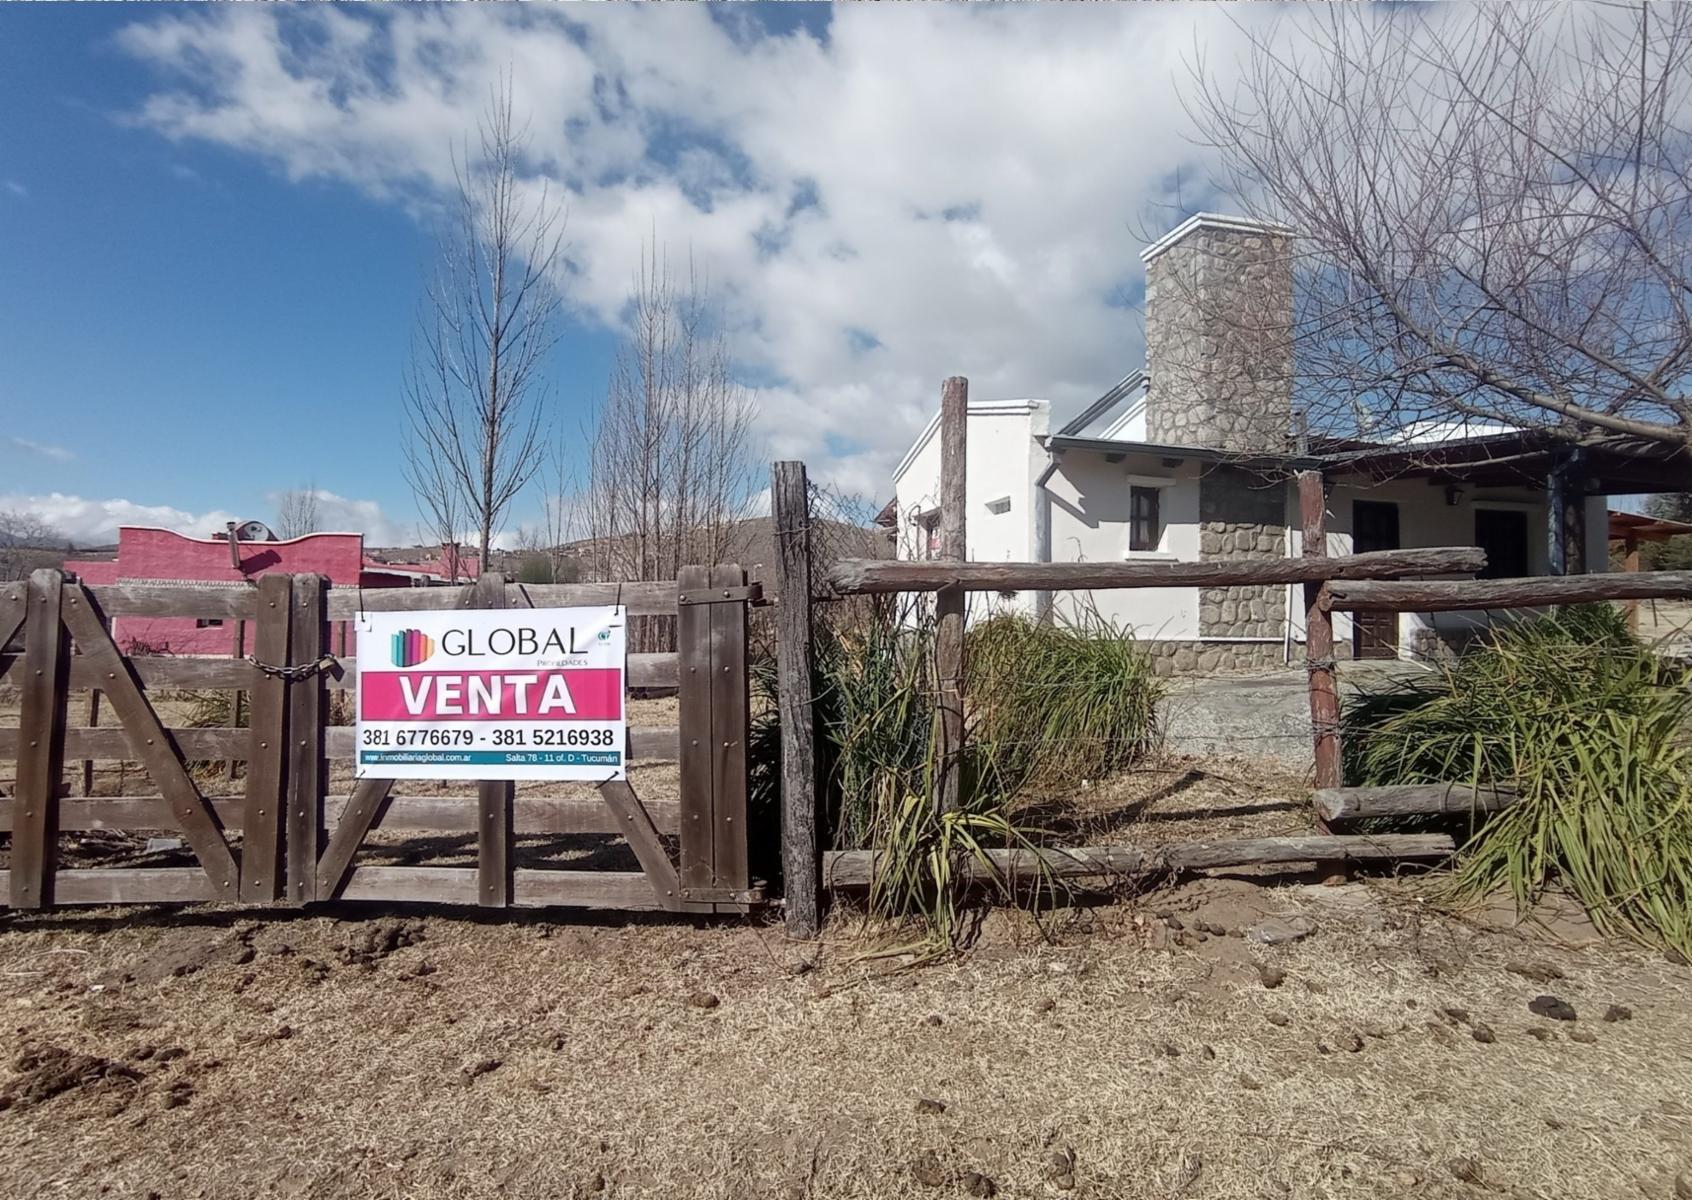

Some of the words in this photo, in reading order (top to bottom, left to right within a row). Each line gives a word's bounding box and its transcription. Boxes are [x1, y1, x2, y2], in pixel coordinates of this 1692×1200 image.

[442, 627, 589, 656] GLOBAL
[399, 674, 577, 715] VENTA
[363, 729, 391, 746] 381
[396, 729, 474, 746] 6776679
[492, 729, 527, 746] 381
[532, 729, 615, 746] 5216938
[505, 753, 526, 762] Salta
[527, 753, 538, 762] 78
[544, 753, 554, 762] 11
[567, 753, 575, 762] D
[580, 753, 618, 763] Tucumán
